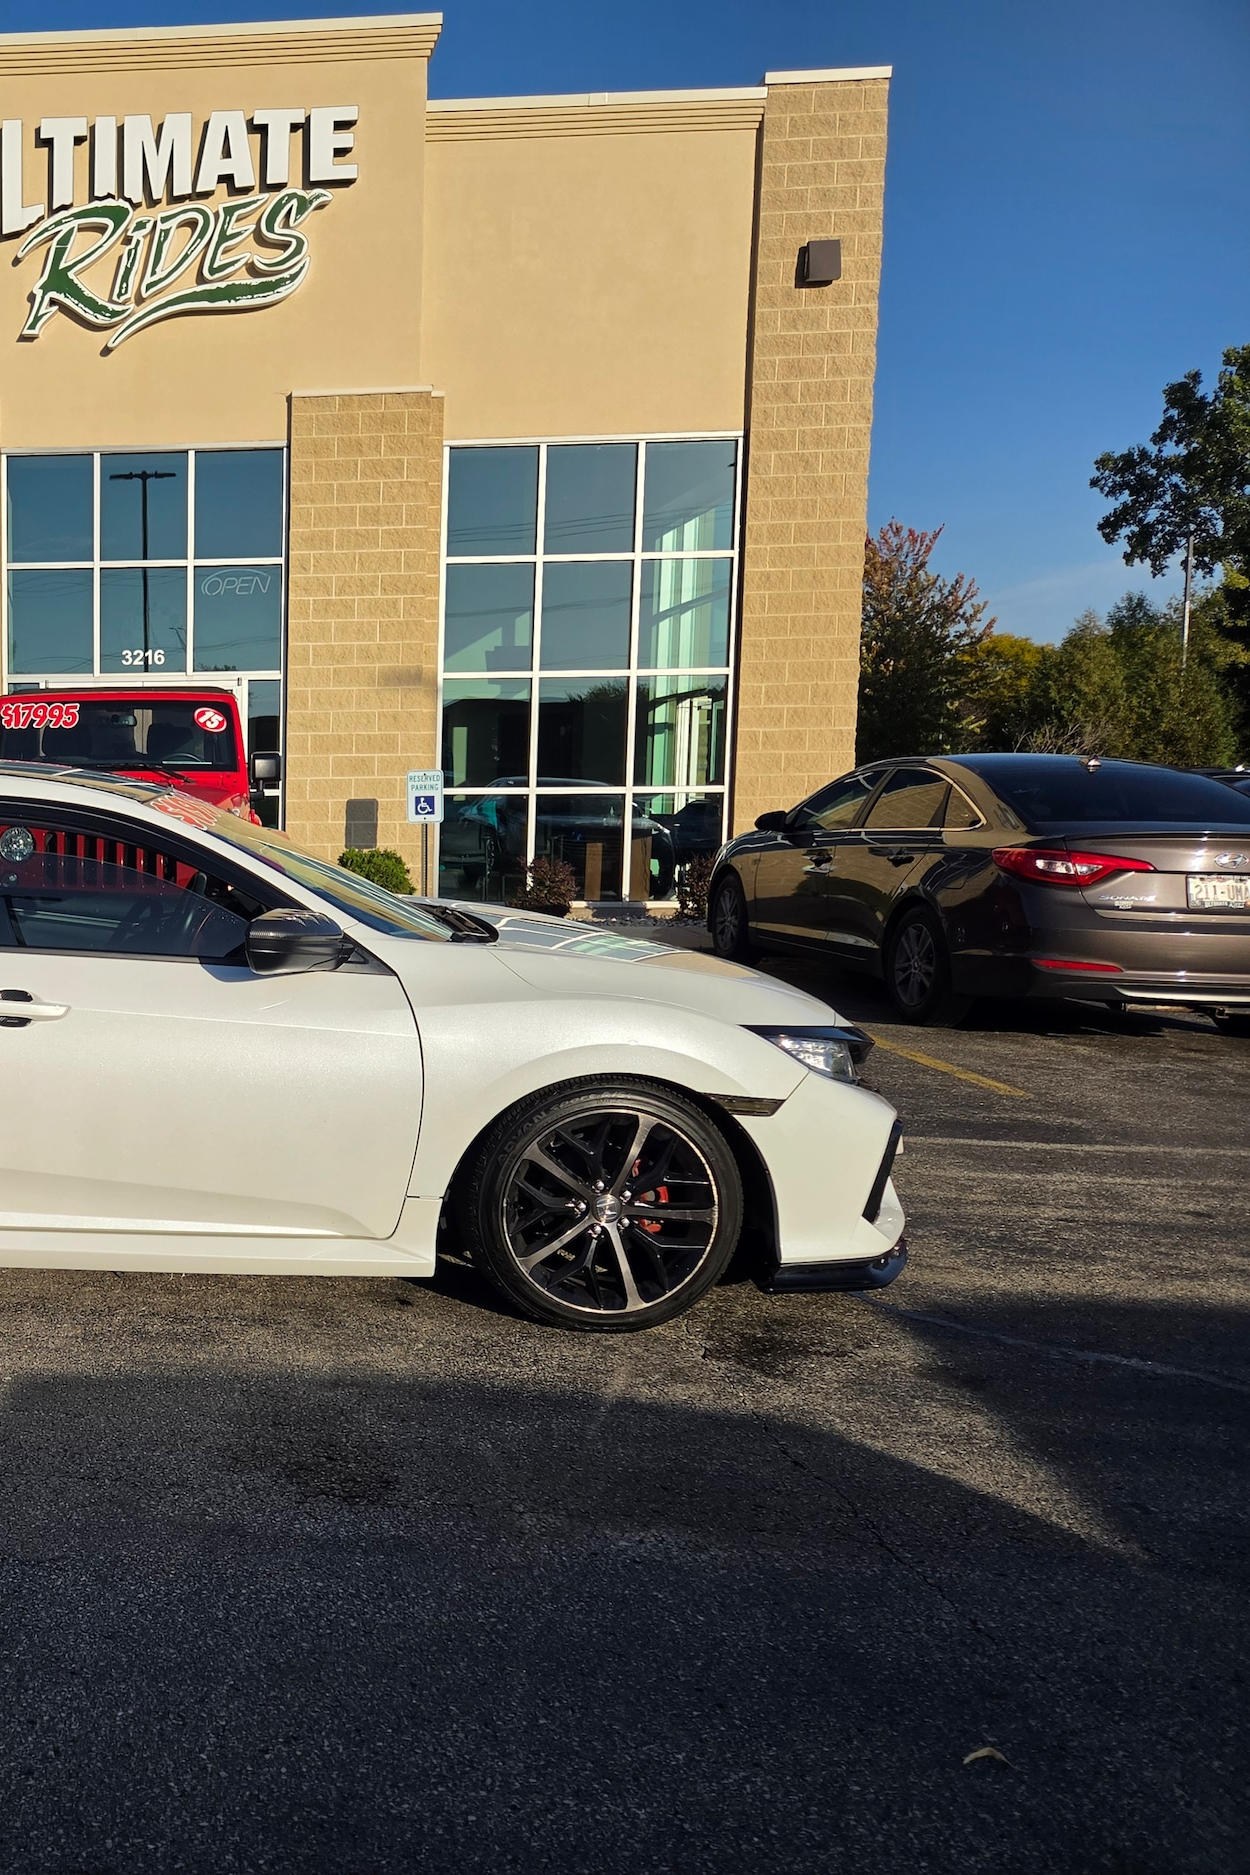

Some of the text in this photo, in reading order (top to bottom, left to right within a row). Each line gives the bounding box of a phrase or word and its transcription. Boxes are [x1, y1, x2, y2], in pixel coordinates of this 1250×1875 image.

[204, 575, 271, 596] OPEN
[121, 649, 166, 666] 3216
[0, 702, 80, 729] $17995
[198, 711, 224, 729] 15
[409, 774, 440, 782] RESERVED
[411, 783, 438, 791] PARKING
